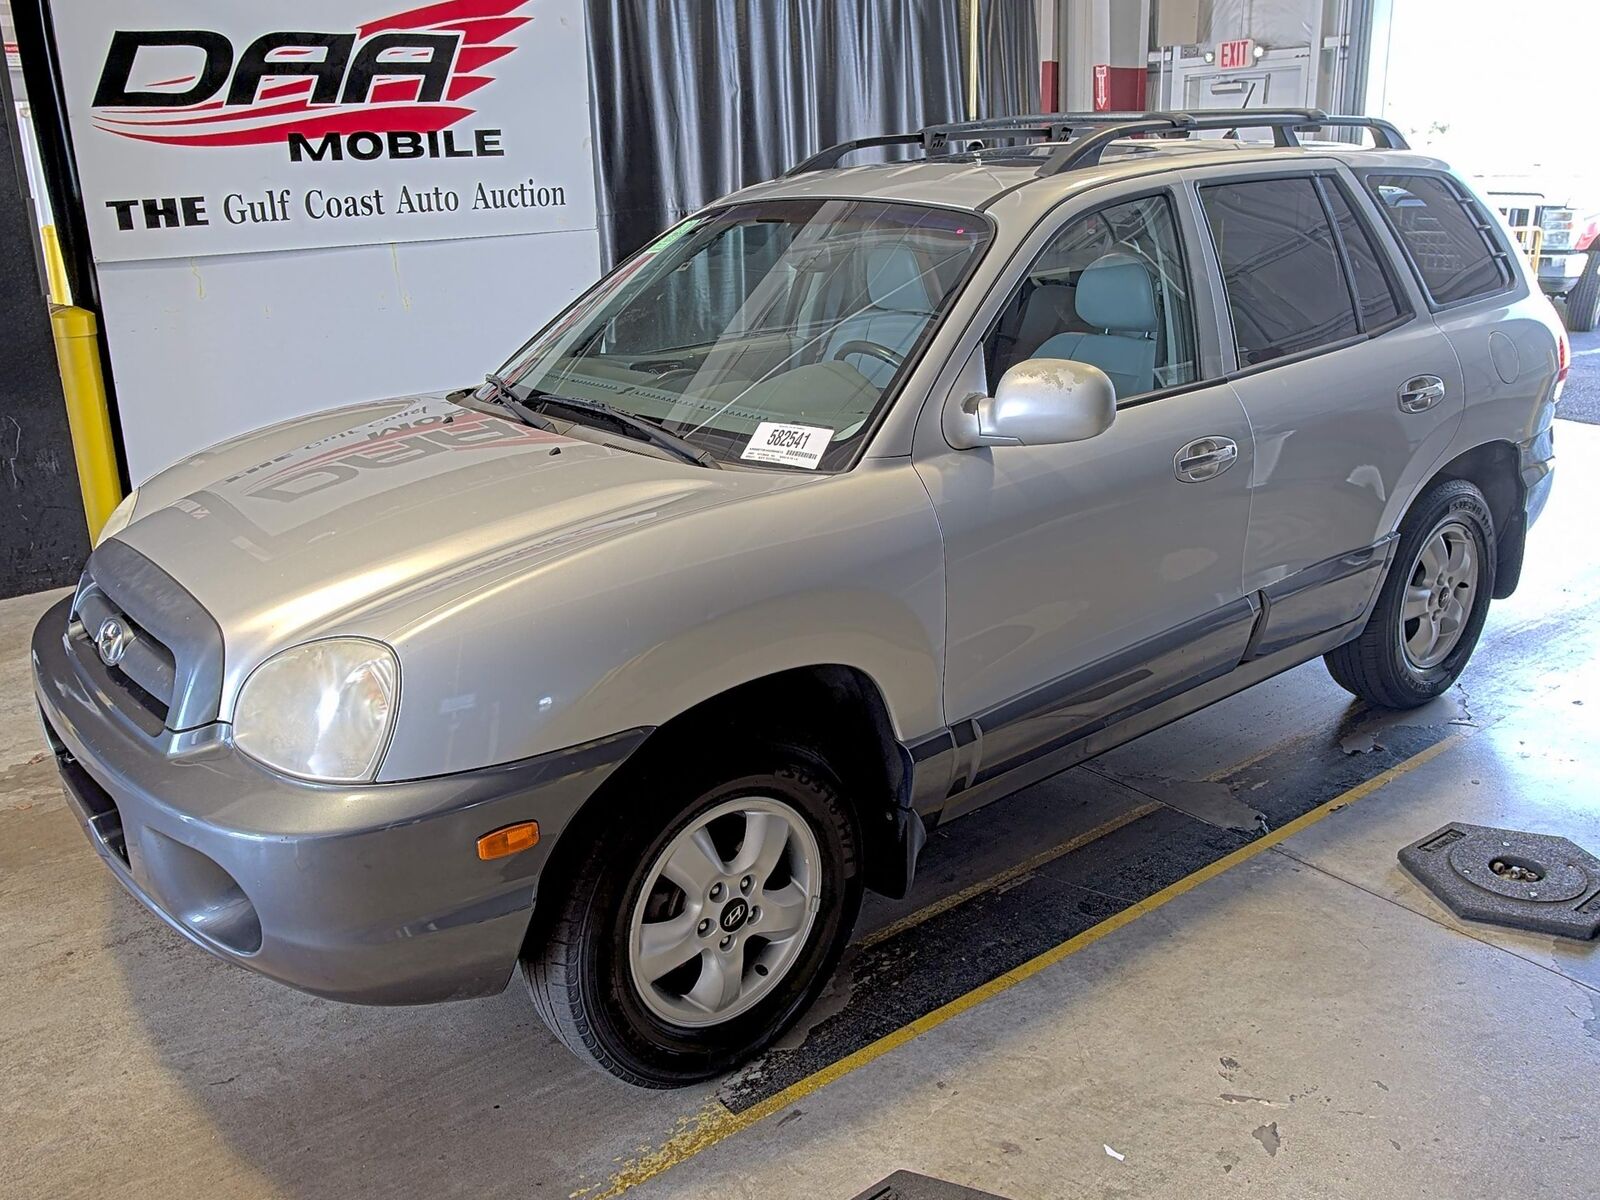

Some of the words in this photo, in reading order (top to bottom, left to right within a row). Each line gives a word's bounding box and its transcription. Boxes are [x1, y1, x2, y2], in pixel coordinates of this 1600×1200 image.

[92, 30, 460, 108] DAA
[1221, 41, 1249, 68] EXIT
[288, 128, 505, 162] MOBILE
[106, 196, 209, 230] THE
[223, 189, 291, 226] Gulf
[305, 188, 385, 220] Coast
[396, 185, 459, 215] Auto
[472, 178, 566, 211] Auction
[767, 429, 811, 450] 582541
